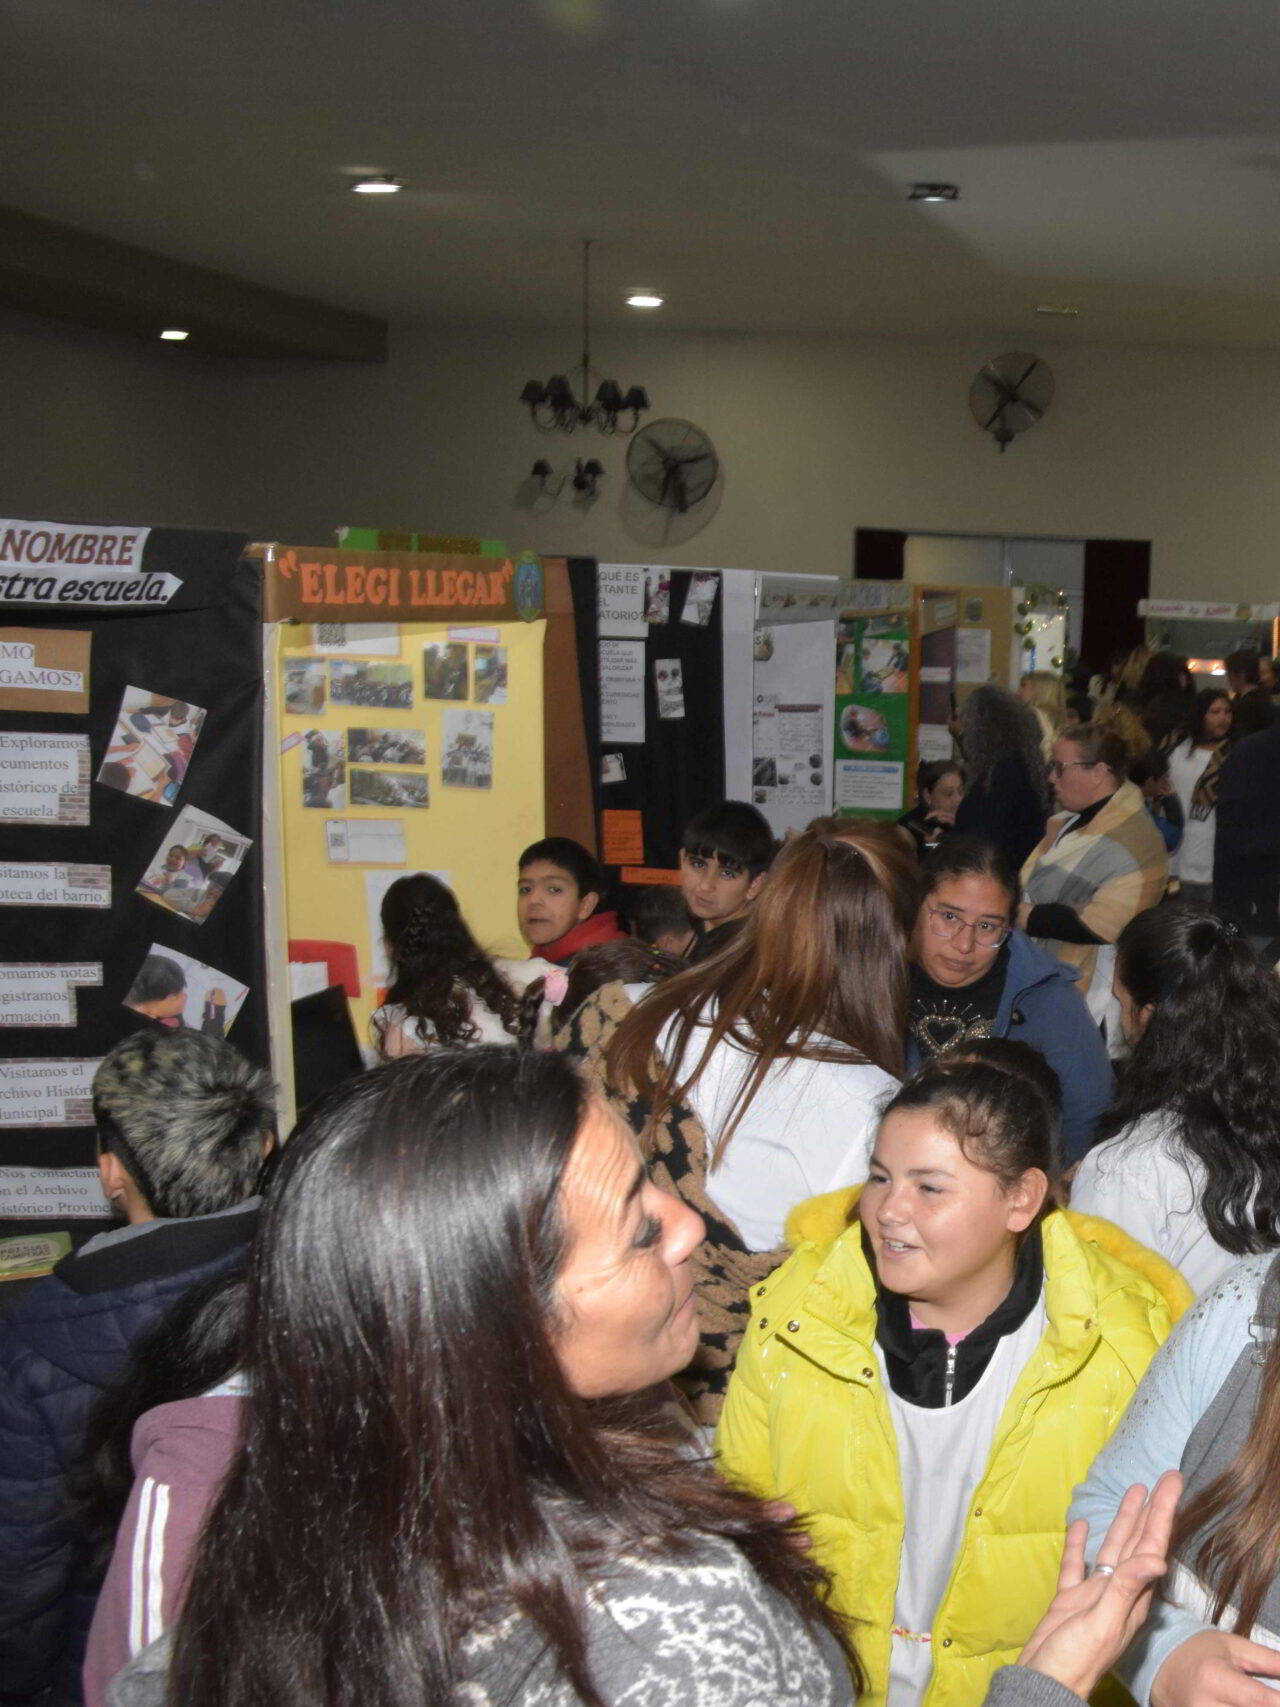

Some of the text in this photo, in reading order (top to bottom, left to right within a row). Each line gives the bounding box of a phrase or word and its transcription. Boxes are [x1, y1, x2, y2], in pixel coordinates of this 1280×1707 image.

[0, 528, 137, 566] NOMBRE
[626, 572, 640, 582] ES
[58, 574, 169, 602] escuela.
[0, 669, 81, 687] GAMOS?
[1, 735, 86, 751] Exploramos
[0, 757, 69, 770] cumentos
[62, 781, 78, 794] de
[3, 805, 58, 818] escuela.
[54, 867, 66, 880] la
[37, 888, 57, 901] del
[63, 888, 106, 903] barrio.
[61, 967, 97, 979] notas
[2, 990, 68, 1005] gistramos
[72, 1064, 84, 1077] el
[16, 1185, 28, 1195] el
[33, 1184, 89, 1196] Archivo
[2, 1202, 53, 1214] istórico
